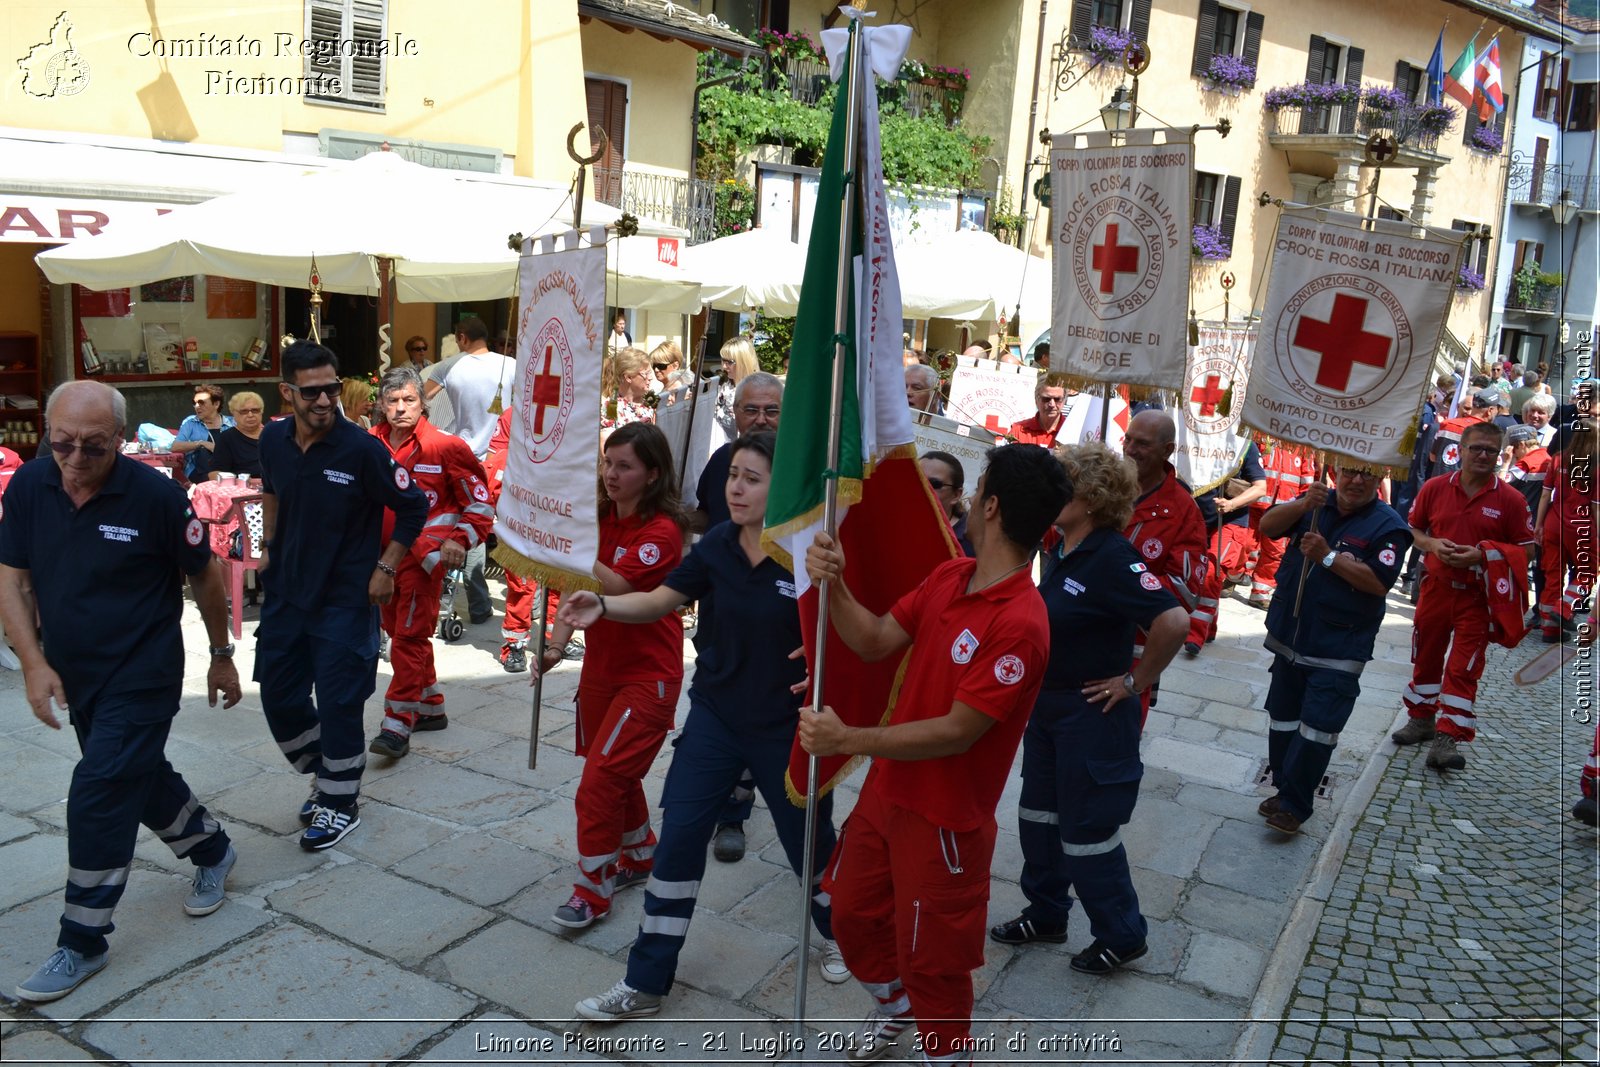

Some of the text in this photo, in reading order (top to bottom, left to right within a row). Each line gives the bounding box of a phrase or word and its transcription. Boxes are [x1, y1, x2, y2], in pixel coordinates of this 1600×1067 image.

[1057, 153, 1186, 171] CORPO VOLONTARI DEL SOCCORSO
[1060, 174, 1178, 249] CROCE ROSSA ITALIANA
[1088, 213, 1097, 228] DI
[1134, 213, 1153, 231] 22
[660, 243, 677, 265] illy
[1288, 224, 1450, 265] CORPO VOLONTARI DEL SOCCORSO
[1145, 233, 1163, 290] AGOSTO
[1277, 239, 1455, 284] CROCE ROSSA ITALIANA
[565, 273, 597, 351] ITALIANA
[1117, 291, 1147, 314] 1864
[1287, 275, 1409, 341] CONVENZIONE DI GINEVRA
[1068, 325, 1160, 346] DELEGAZIONE DI
[1082, 347, 1132, 367] BARGE
[1256, 394, 1396, 439] COMITATO LOCALE DI
[1269, 418, 1374, 455] RACCONIGI
[529, 511, 537, 524] DI
[537, 494, 572, 518] LOCALE
[99, 525, 139, 537] CROCE ROSSA
[104, 532, 131, 542] ITALIANA
[527, 526, 572, 555] PIEMONTE
